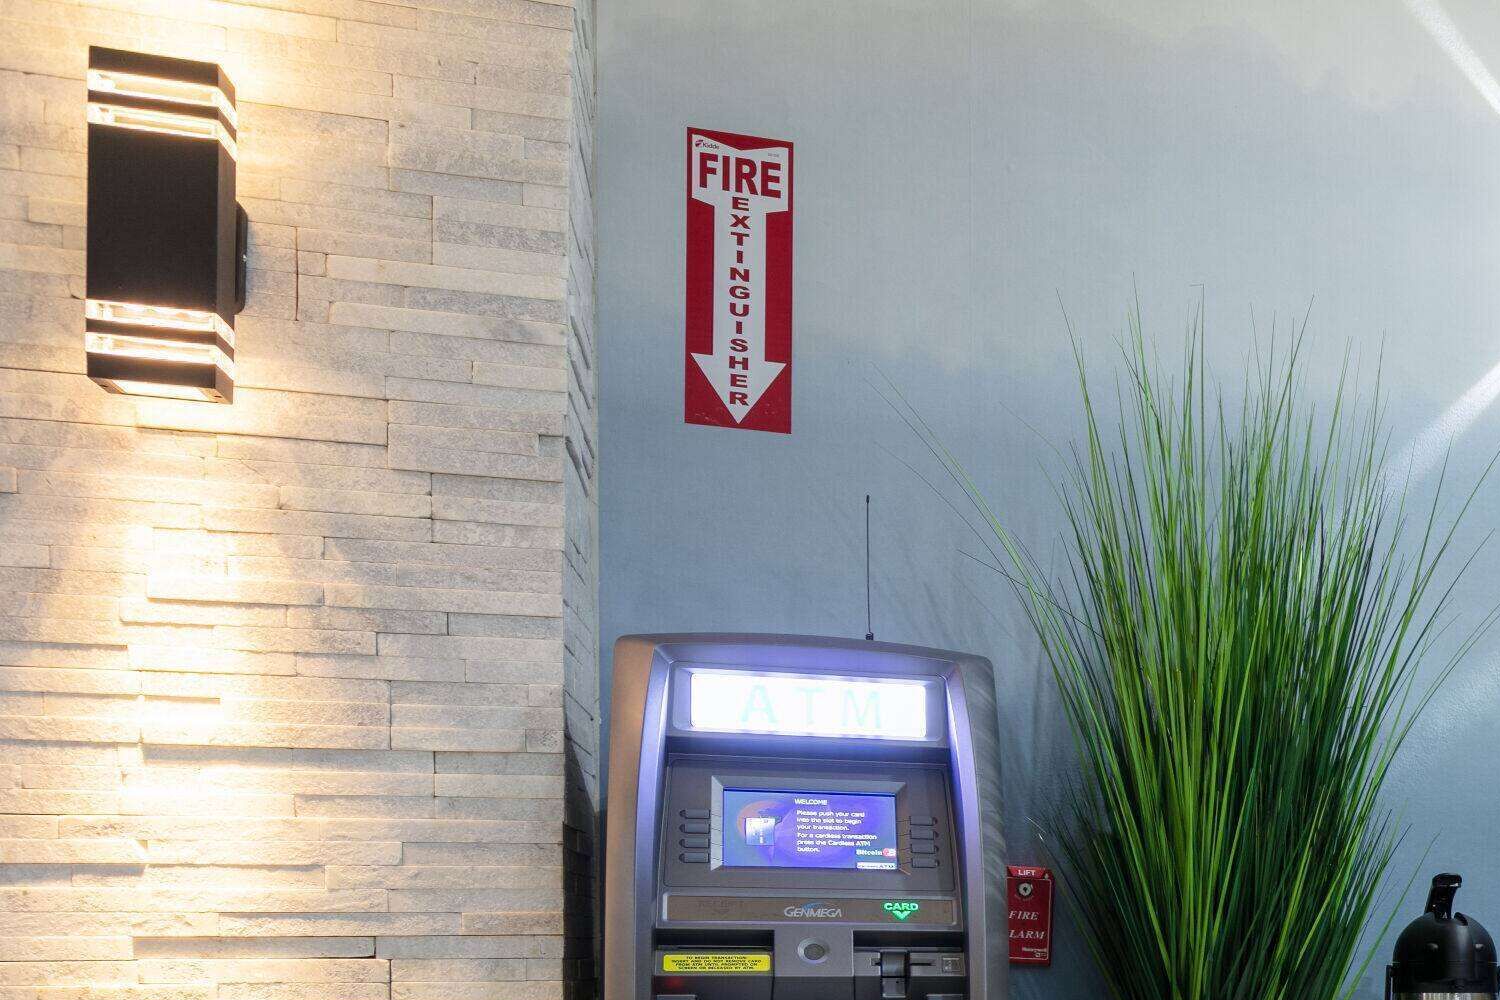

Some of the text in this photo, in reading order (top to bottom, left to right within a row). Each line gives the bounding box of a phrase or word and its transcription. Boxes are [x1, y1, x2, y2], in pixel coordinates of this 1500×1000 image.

[700, 152, 781, 198] FIRE
[729, 196, 751, 406] EXTINGUISHER
[740, 684, 881, 729] ATM
[784, 906, 842, 918] GENMEGA
[883, 902, 919, 911] CARD
[1009, 910, 1040, 920] FIRE
[1008, 929, 1045, 940] LARM
